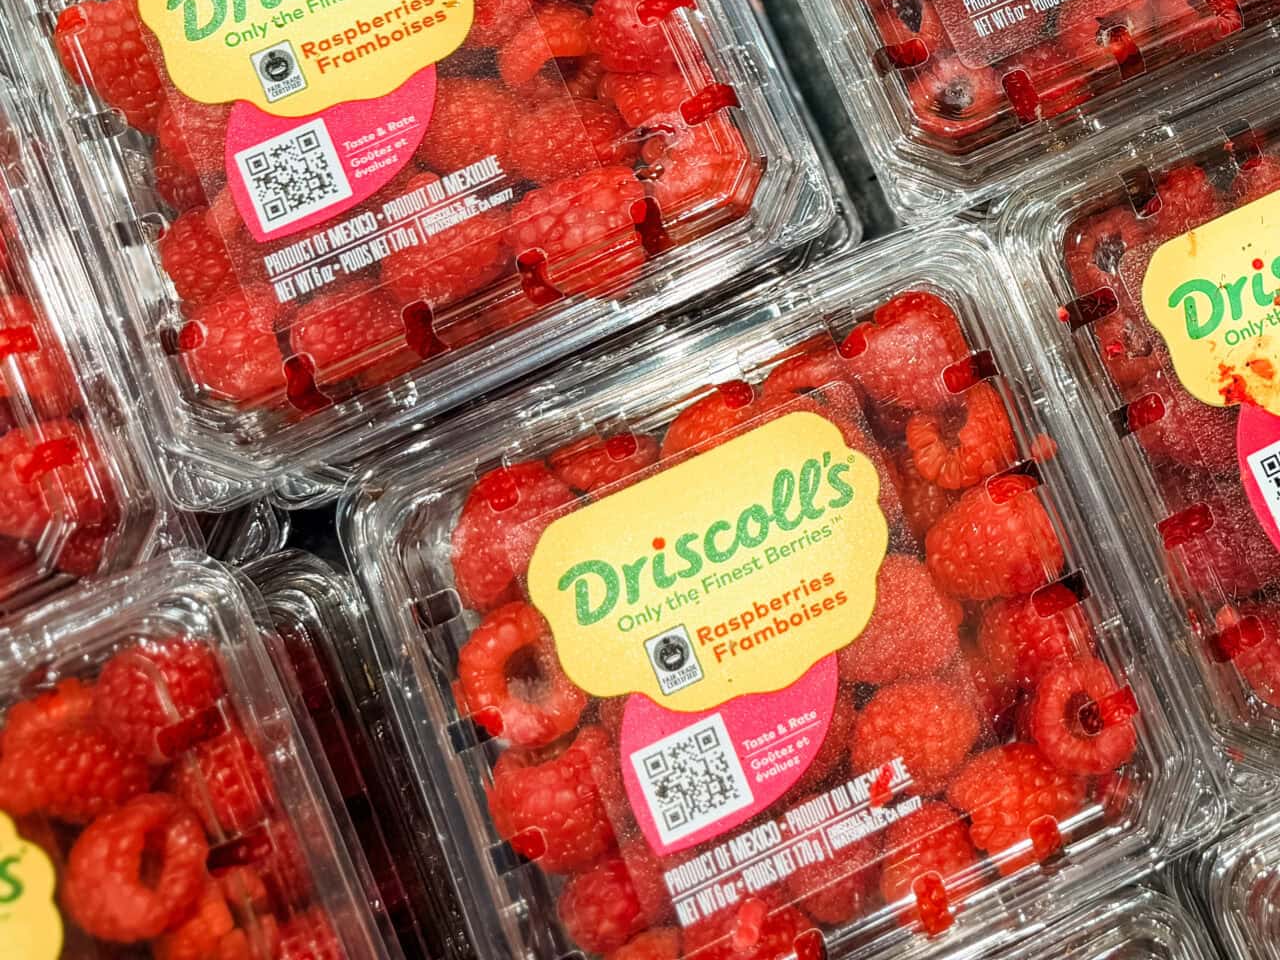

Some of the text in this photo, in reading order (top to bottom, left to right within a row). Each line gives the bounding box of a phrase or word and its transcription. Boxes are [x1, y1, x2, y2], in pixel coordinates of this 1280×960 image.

[225, 20, 266, 49] Only
[270, 8, 304, 29] the
[317, 9, 447, 75] Framboises
[972, 15, 994, 38] NET
[989, 8, 1009, 30] WT
[1012, 4, 1027, 21] oz
[341, 114, 417, 151] Taste & Rate
[395, 136, 408, 148] et
[263, 154, 503, 277] PRODUCT OF MEXICO PRODUIT DU MEXIQUE
[1225, 318, 1262, 347] Only
[618, 602, 660, 635] Only
[665, 588, 700, 612] the
[701, 555, 763, 595] Finest
[696, 570, 835, 646] Raspberries
[713, 589, 848, 664] Framboises
